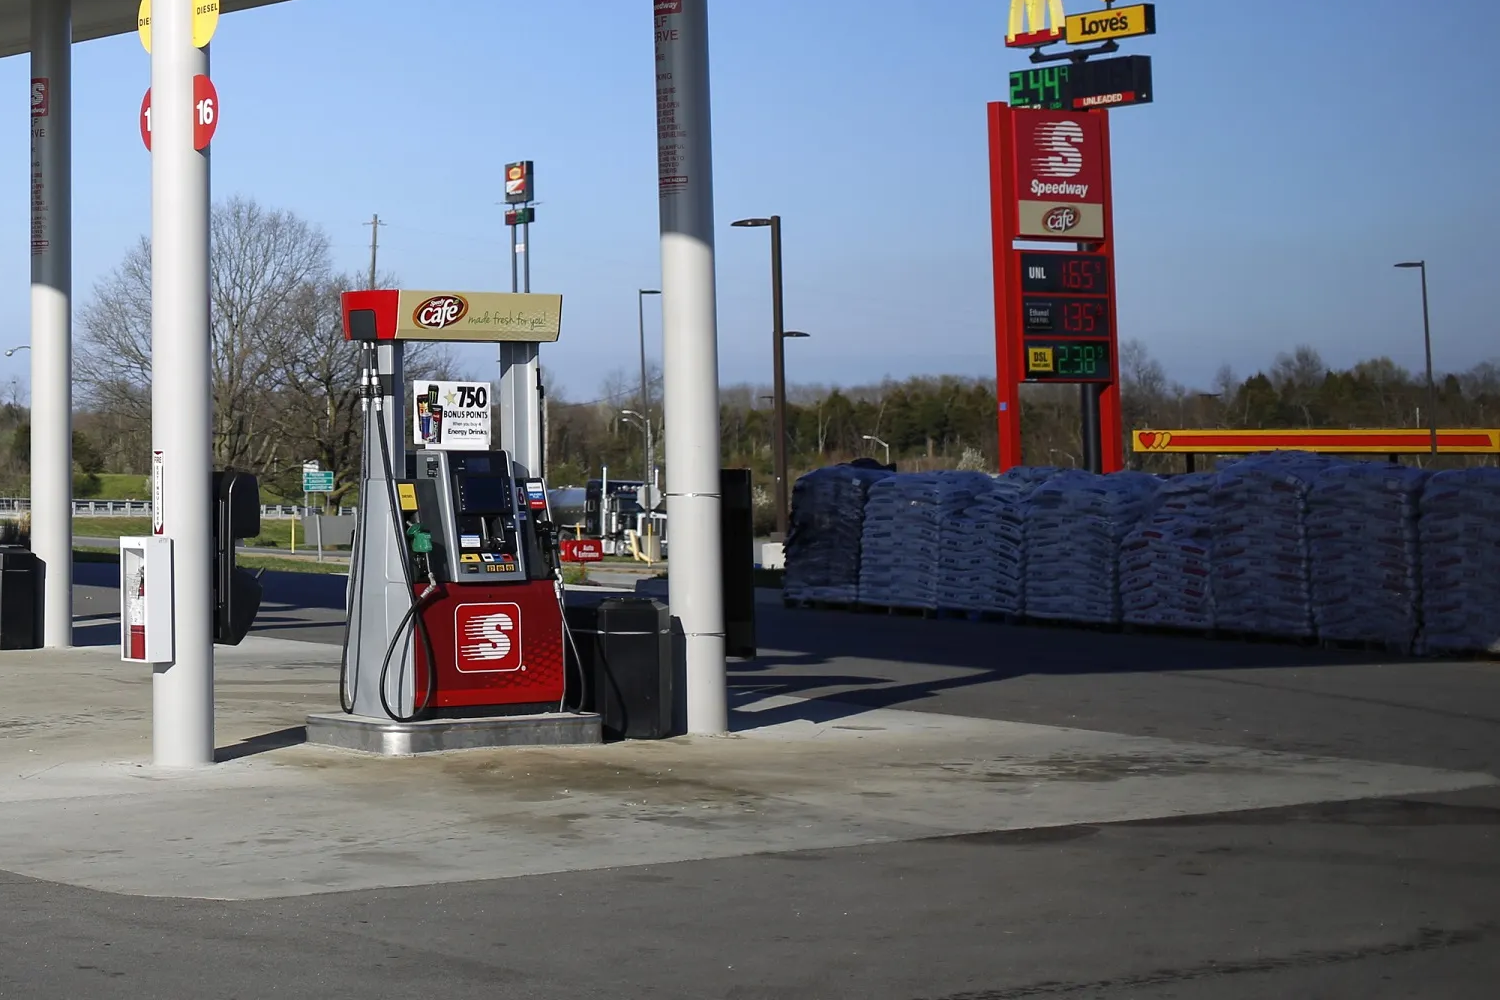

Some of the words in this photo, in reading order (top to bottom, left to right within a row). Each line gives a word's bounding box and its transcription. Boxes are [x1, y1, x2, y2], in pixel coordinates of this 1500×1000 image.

[196, 3, 218, 15] DIESEL
[654, 16, 667, 28] LF
[1082, 93, 1123, 106] UNLEADED
[196, 98, 214, 125] 16
[1031, 179, 1089, 198] Speedway
[1029, 266, 1047, 279] UNL
[467, 311, 490, 325] made
[493, 310, 515, 326] fresh
[516, 311, 528, 325] for
[529, 312, 547, 330] you!
[1033, 352, 1048, 362] DSL
[457, 386, 487, 408] 750
[443, 410, 465, 419] BONUS
[466, 411, 488, 419] POINTS
